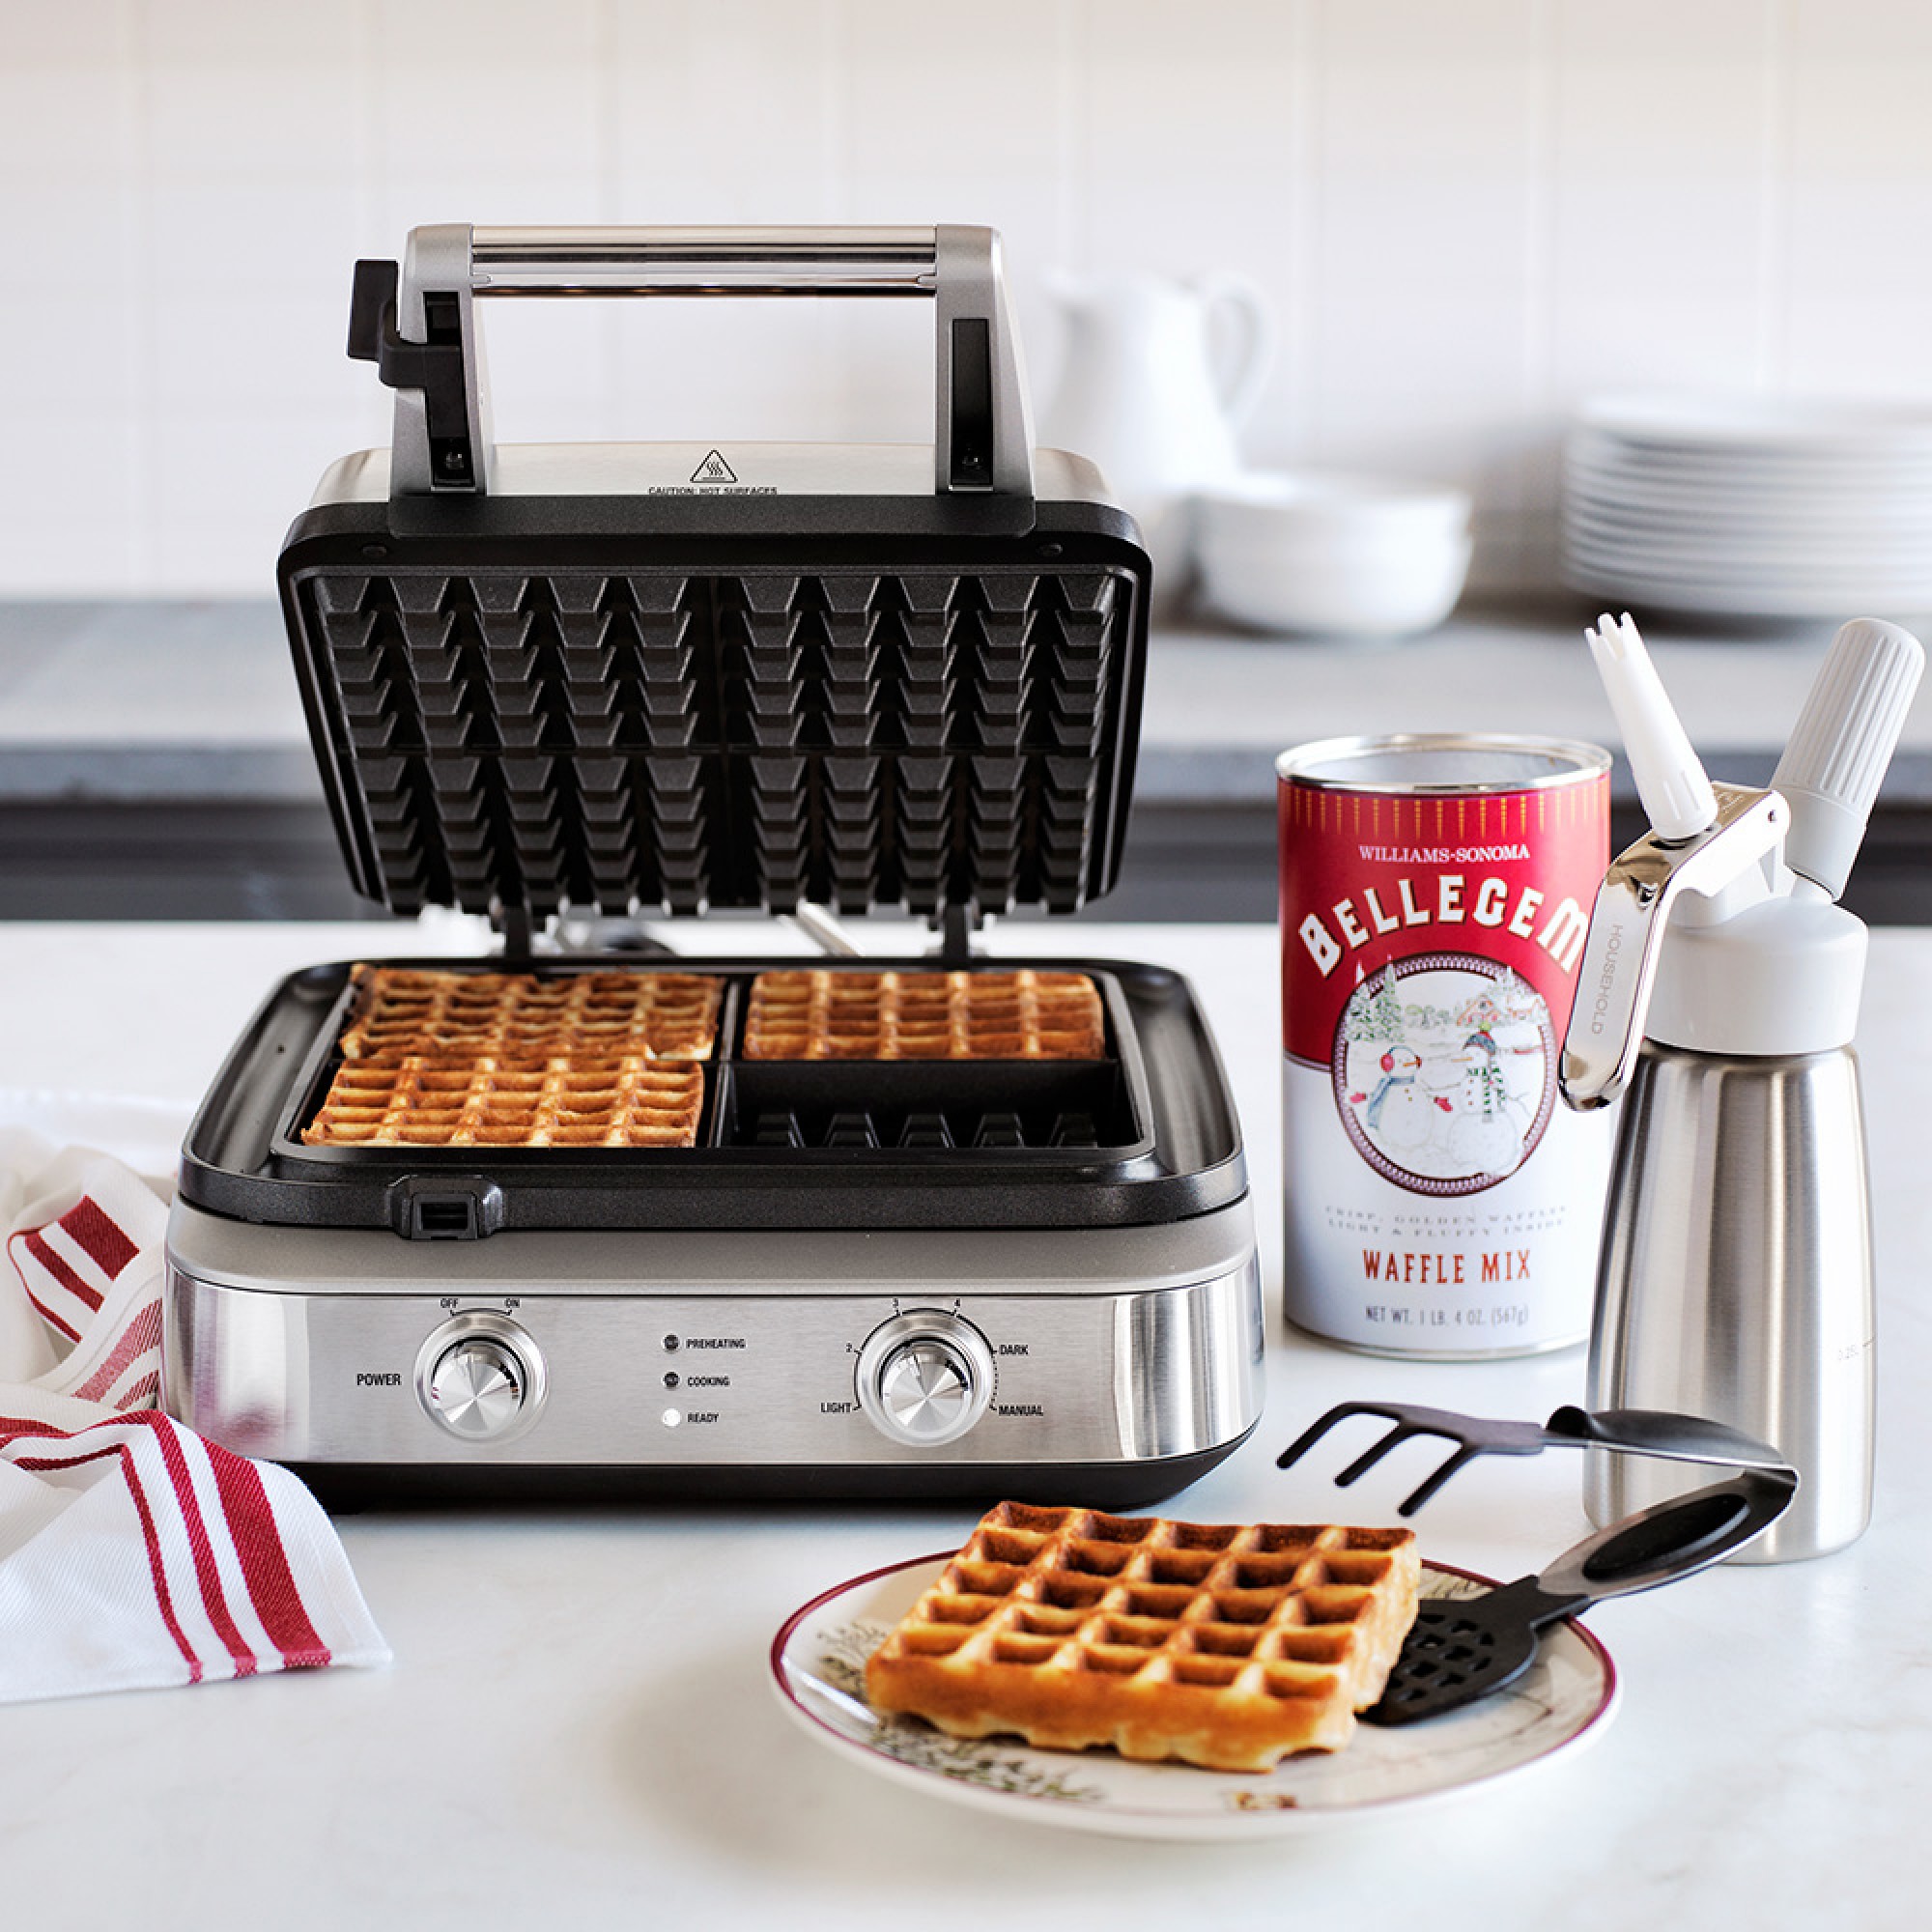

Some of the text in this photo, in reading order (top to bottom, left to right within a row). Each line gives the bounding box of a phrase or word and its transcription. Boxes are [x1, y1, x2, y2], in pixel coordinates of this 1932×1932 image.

[1358, 843, 1530, 865] WILLIAMS-SONOMA
[1298, 874, 1592, 978] BELLEGEM
[1591, 923, 1624, 1035] HOUSEHOLD
[1362, 1249, 1530, 1284] WAFFLE MIX
[440, 1298, 459, 1309] OFF
[505, 1298, 520, 1309] ON
[1365, 1306, 1386, 1322] NET
[1390, 1307, 1414, 1324] WT.
[1455, 1309, 1462, 1325] 4
[685, 1337, 746, 1350] PREHEATING
[998, 1344, 1029, 1355] DARK
[356, 1373, 401, 1386] POWER
[686, 1376, 730, 1387] COOKING
[820, 1402, 851, 1413] LIGHT
[998, 1405, 1044, 1416] MANUAL
[687, 1412, 720, 1424] READY
